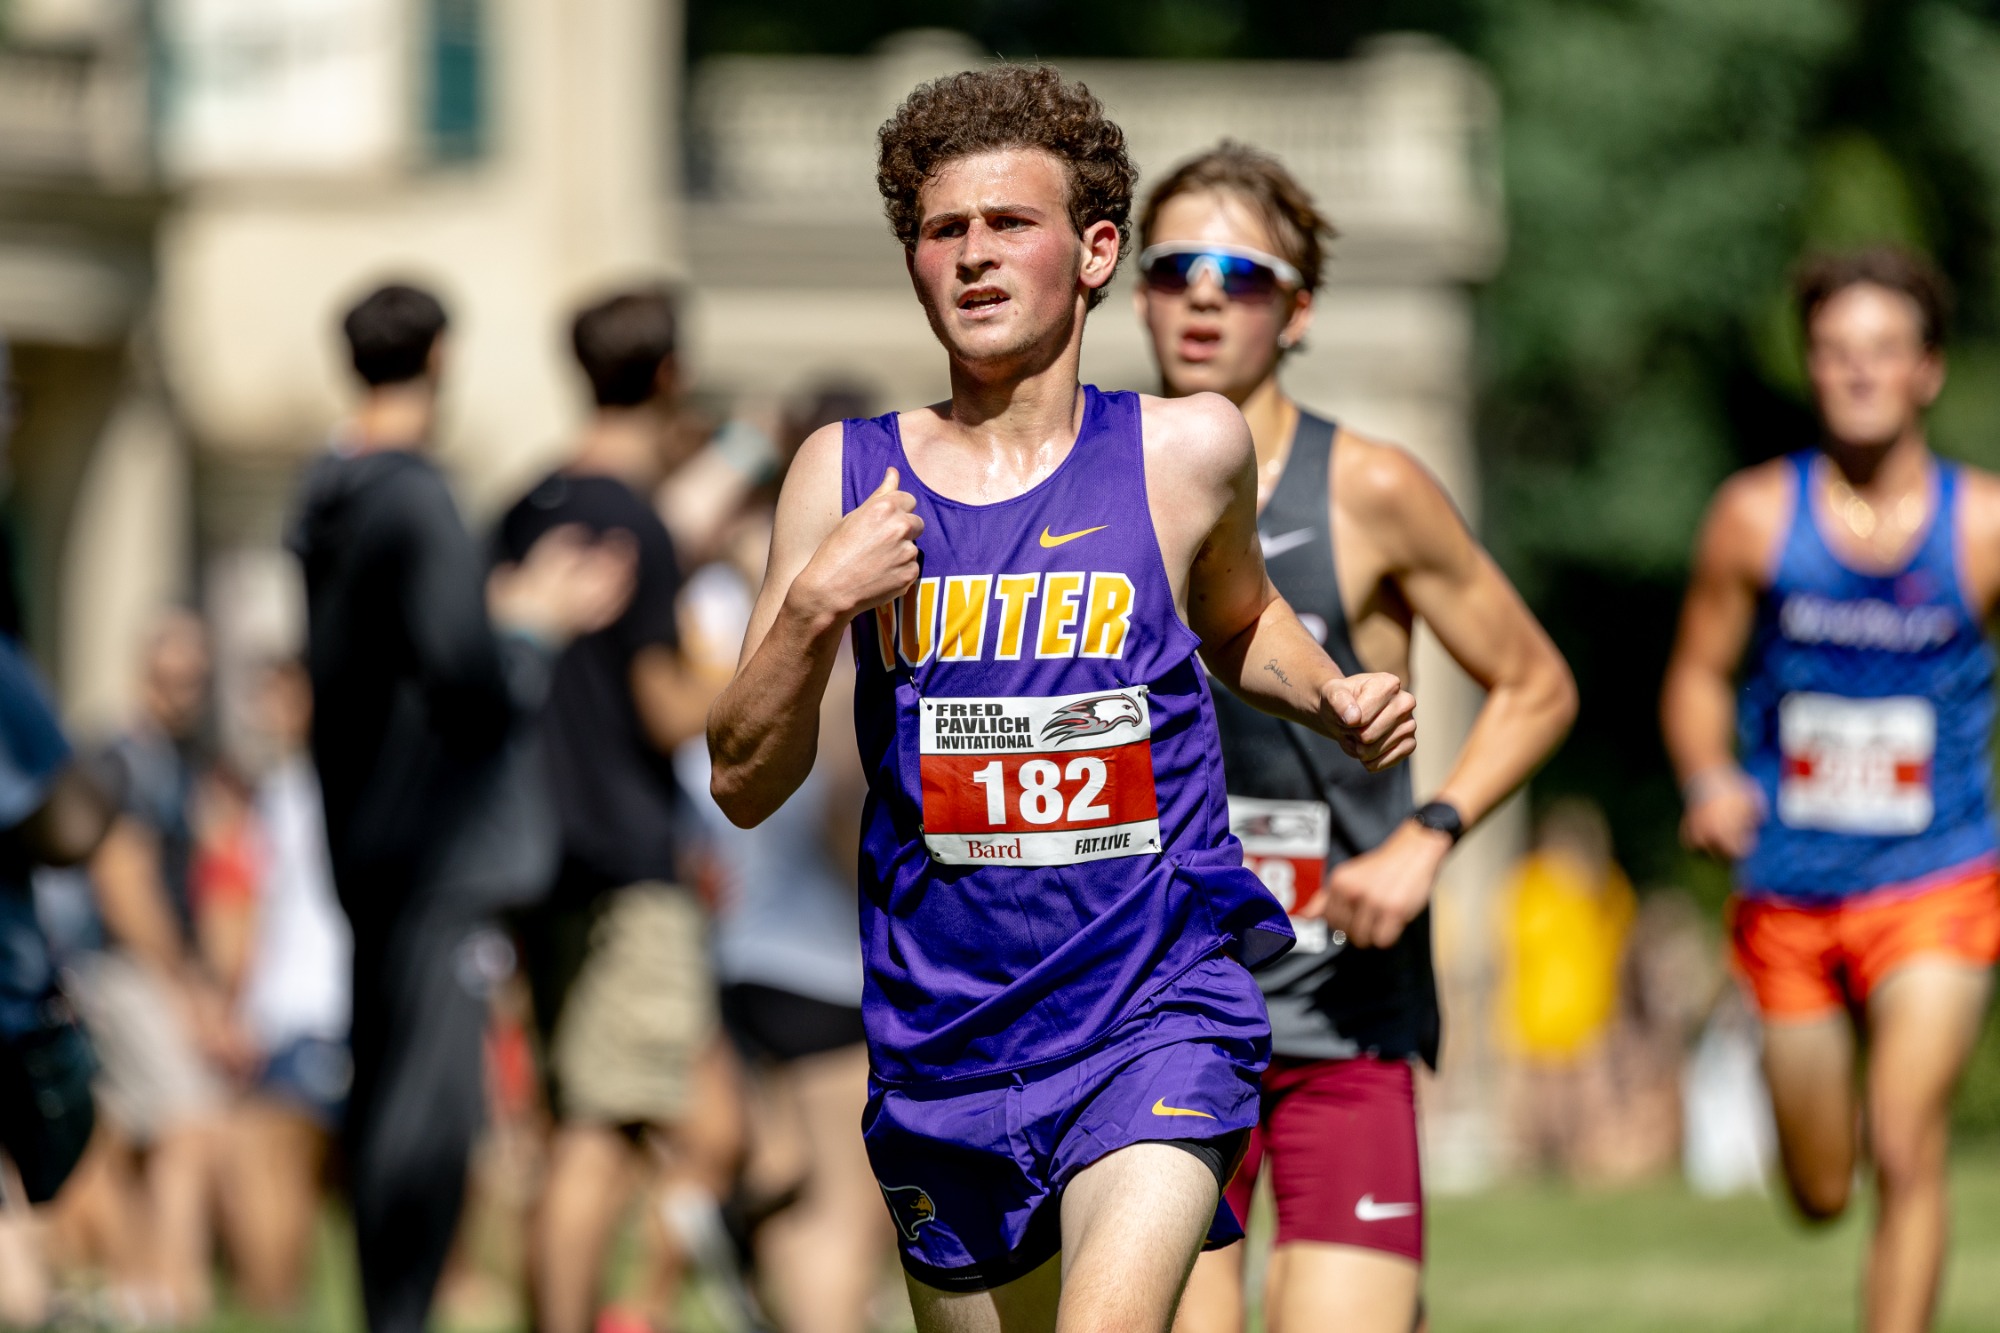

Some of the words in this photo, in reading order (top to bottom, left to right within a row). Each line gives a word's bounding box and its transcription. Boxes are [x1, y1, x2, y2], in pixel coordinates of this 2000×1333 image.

[936, 703, 1003, 716] FRED
[935, 717, 1031, 733] PAVLICH
[936, 734, 1034, 749] INVITATIONAL
[972, 756, 1110, 825] 182
[967, 838, 1023, 859] Bard
[1074, 832, 1131, 855] FAT.LIVE
